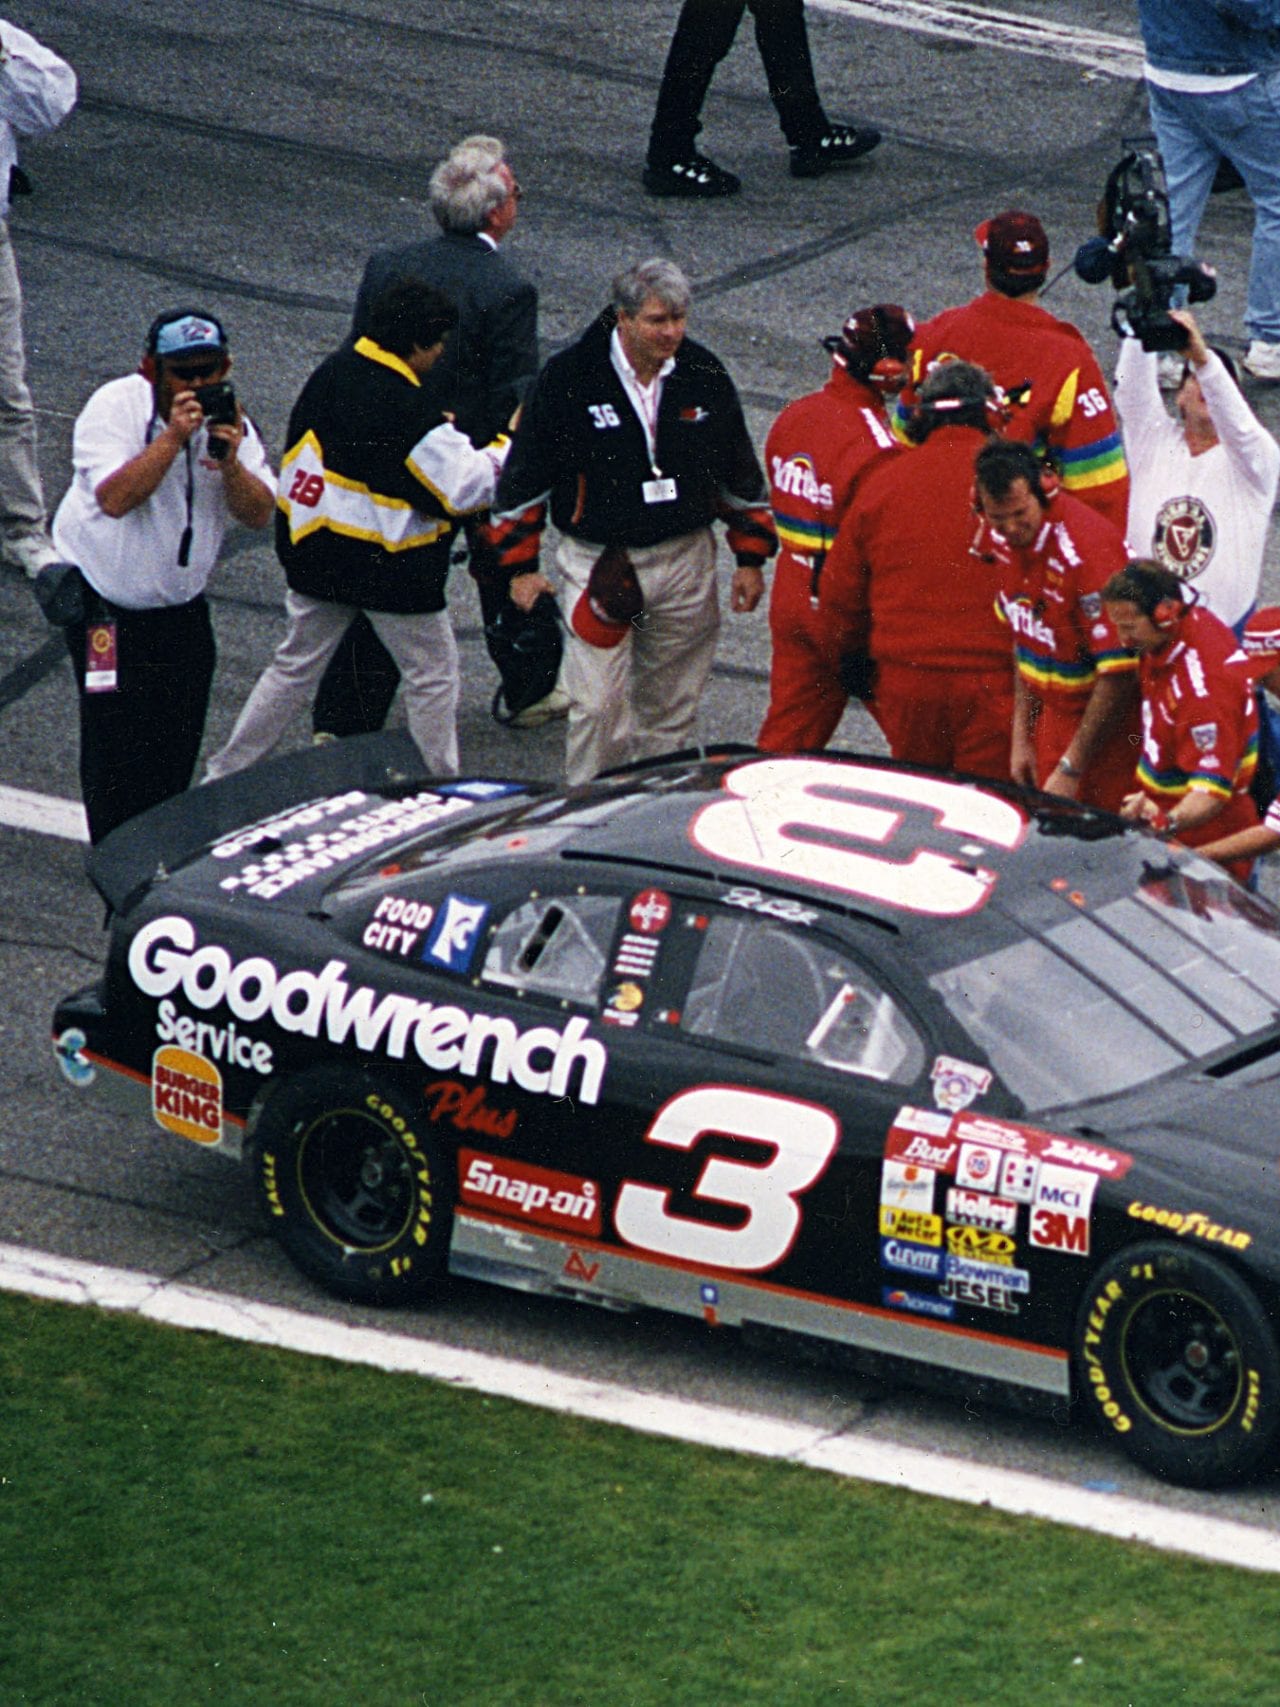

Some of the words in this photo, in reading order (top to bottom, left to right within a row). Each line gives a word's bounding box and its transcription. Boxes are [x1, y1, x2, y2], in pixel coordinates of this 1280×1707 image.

[587, 403, 621, 429] 36
[1077, 387, 1108, 418] 36
[288, 467, 325, 508] 28
[687, 758, 1031, 918] 3
[374, 896, 434, 930] FOOD
[363, 921, 417, 956] CITY
[127, 915, 609, 1105] Goodwrench
[155, 999, 274, 1075] Service
[155, 1064, 221, 1104] BURGER
[155, 1084, 221, 1129] KING
[424, 1080, 520, 1140] Plus
[365, 1094, 432, 1247] GOODYEAR
[903, 1137, 957, 1164] Bud
[263, 1152, 286, 1217] EAGLE
[463, 1159, 597, 1221] Snap-on
[612, 1083, 842, 1274] 3
[1039, 1186, 1081, 1207] MCI
[896, 1224, 937, 1241] Meter
[900, 1212, 933, 1228] Auto
[1032, 1209, 1088, 1253] 3M
[1127, 1201, 1252, 1250] GOODYEAR
[948, 1257, 1028, 1289] Bowman
[939, 1279, 1020, 1314] JESEL
[1083, 1279, 1132, 1433] GOODYEAR
[1241, 1368, 1260, 1433] EAGLE
